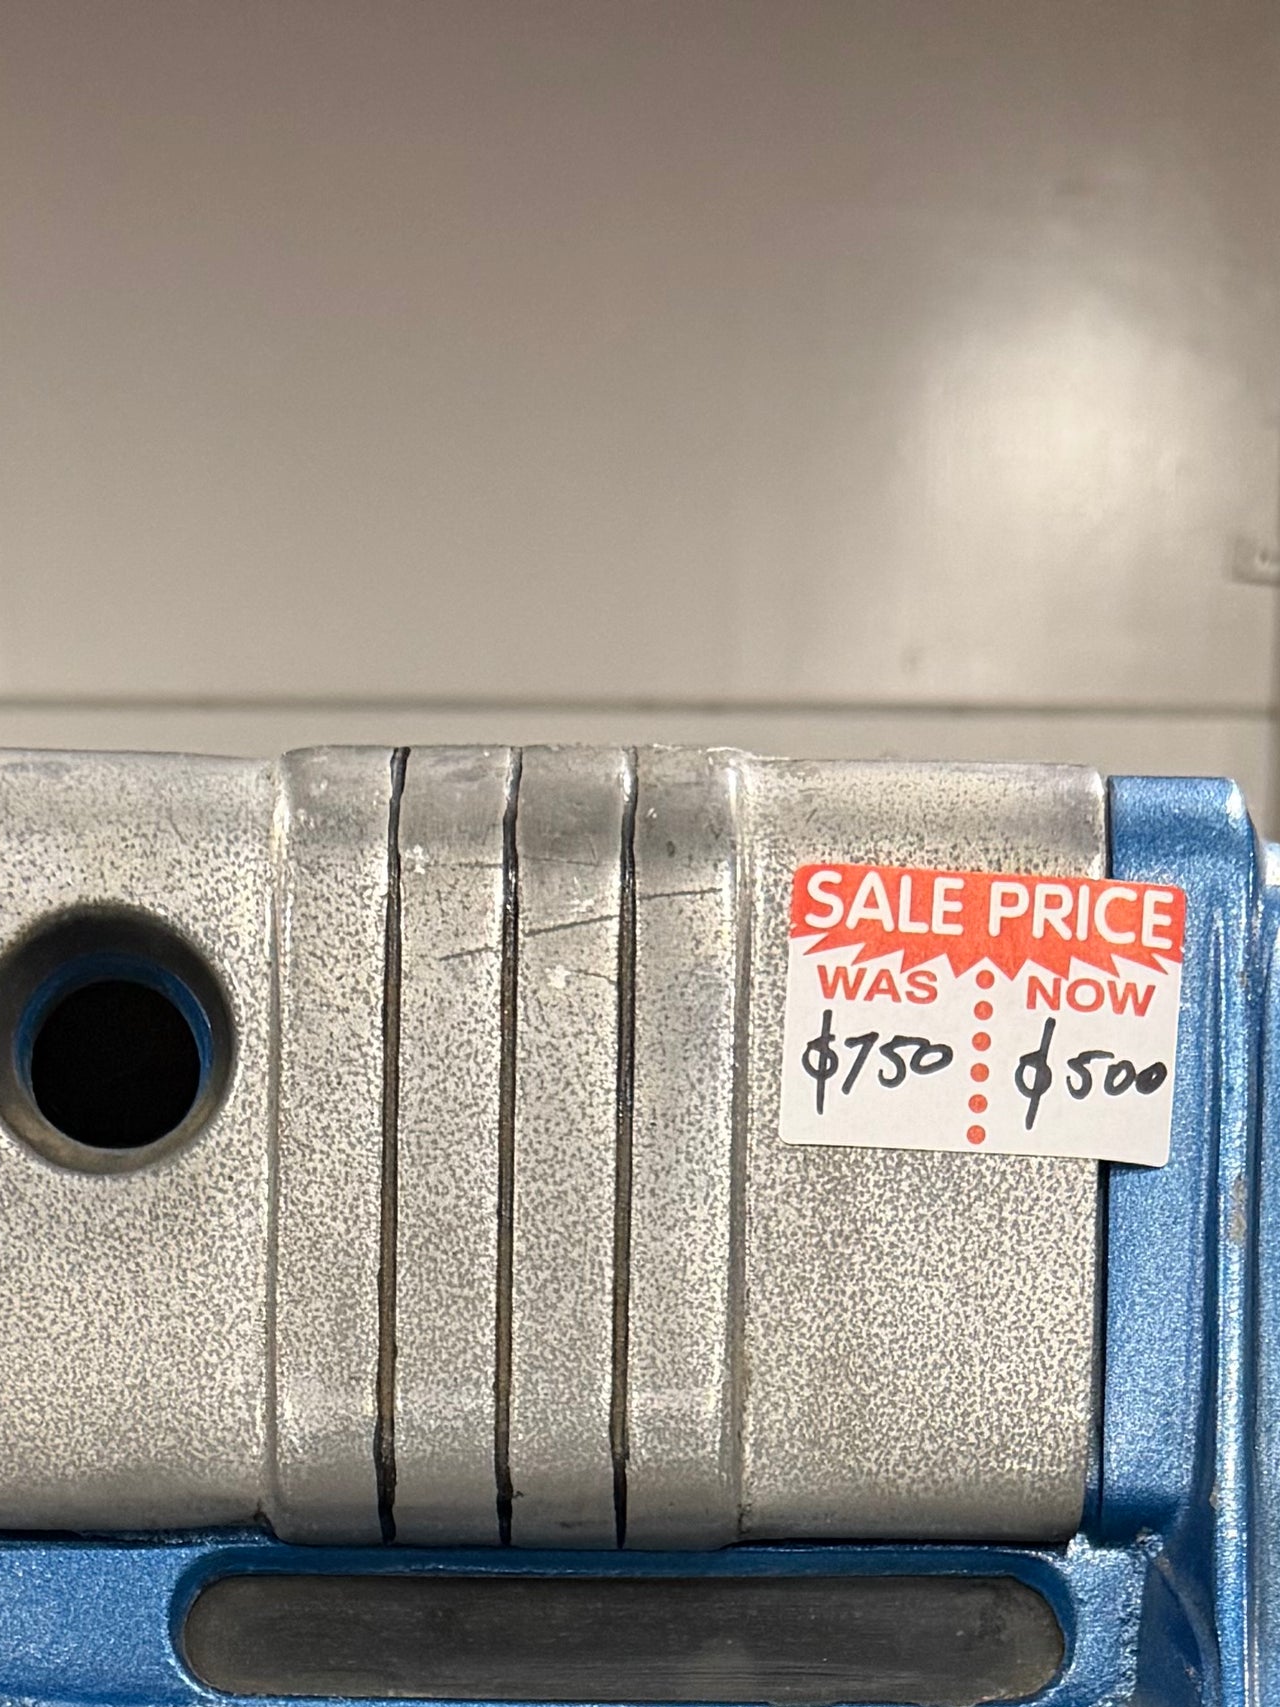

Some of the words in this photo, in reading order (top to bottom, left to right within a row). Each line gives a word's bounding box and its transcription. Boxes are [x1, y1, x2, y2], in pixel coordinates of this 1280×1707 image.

[805, 870, 964, 937] SALE
[987, 881, 1173, 949] PRICE
[817, 965, 937, 1003] WAS
[1026, 976, 1156, 1016] NOW
[802, 1009, 953, 1114] $750
[1014, 1018, 1168, 1130] $500
